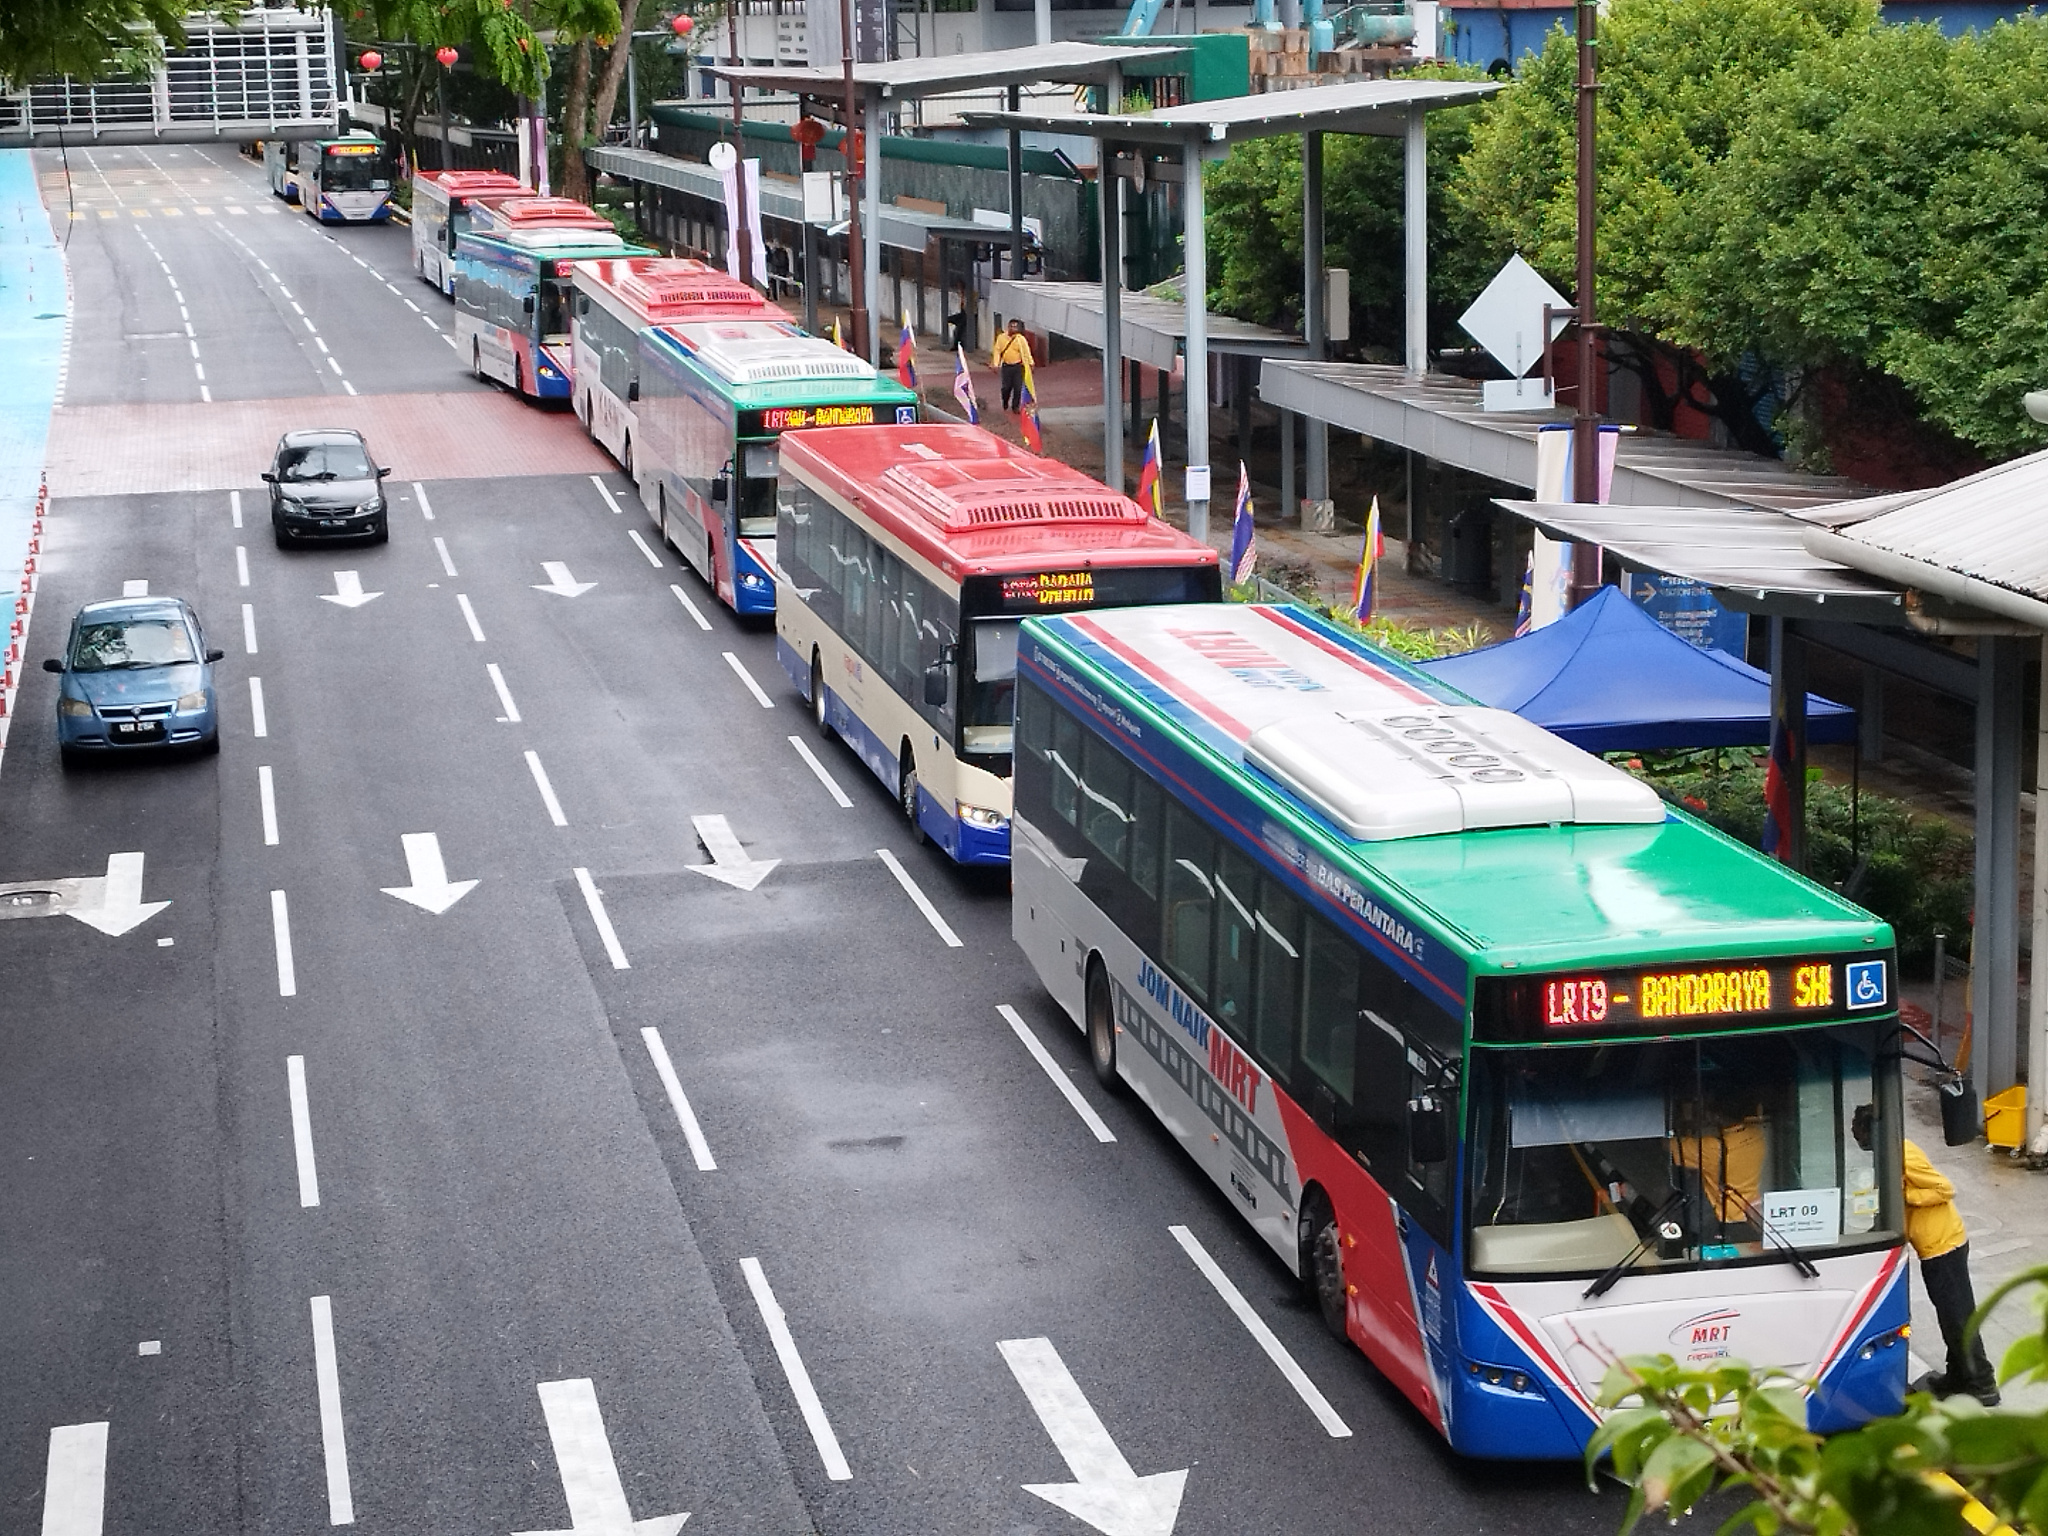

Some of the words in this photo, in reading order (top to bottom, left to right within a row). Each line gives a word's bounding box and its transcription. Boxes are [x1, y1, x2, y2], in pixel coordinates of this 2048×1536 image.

[1317, 865, 1342, 897] BAS
[1341, 883, 1414, 954] PERANTARA
[1548, 981, 1607, 1024] LRT9
[1641, 969, 1771, 1019] BANDARAYA
[1137, 961, 1170, 1011] JOM
[1171, 989, 1211, 1051] NAIK
[1209, 1027, 1262, 1114] MRT
[1770, 1206, 1796, 1218] LRT
[1801, 1205, 1819, 1217] 09
[1690, 1325, 1731, 1344] MRT
